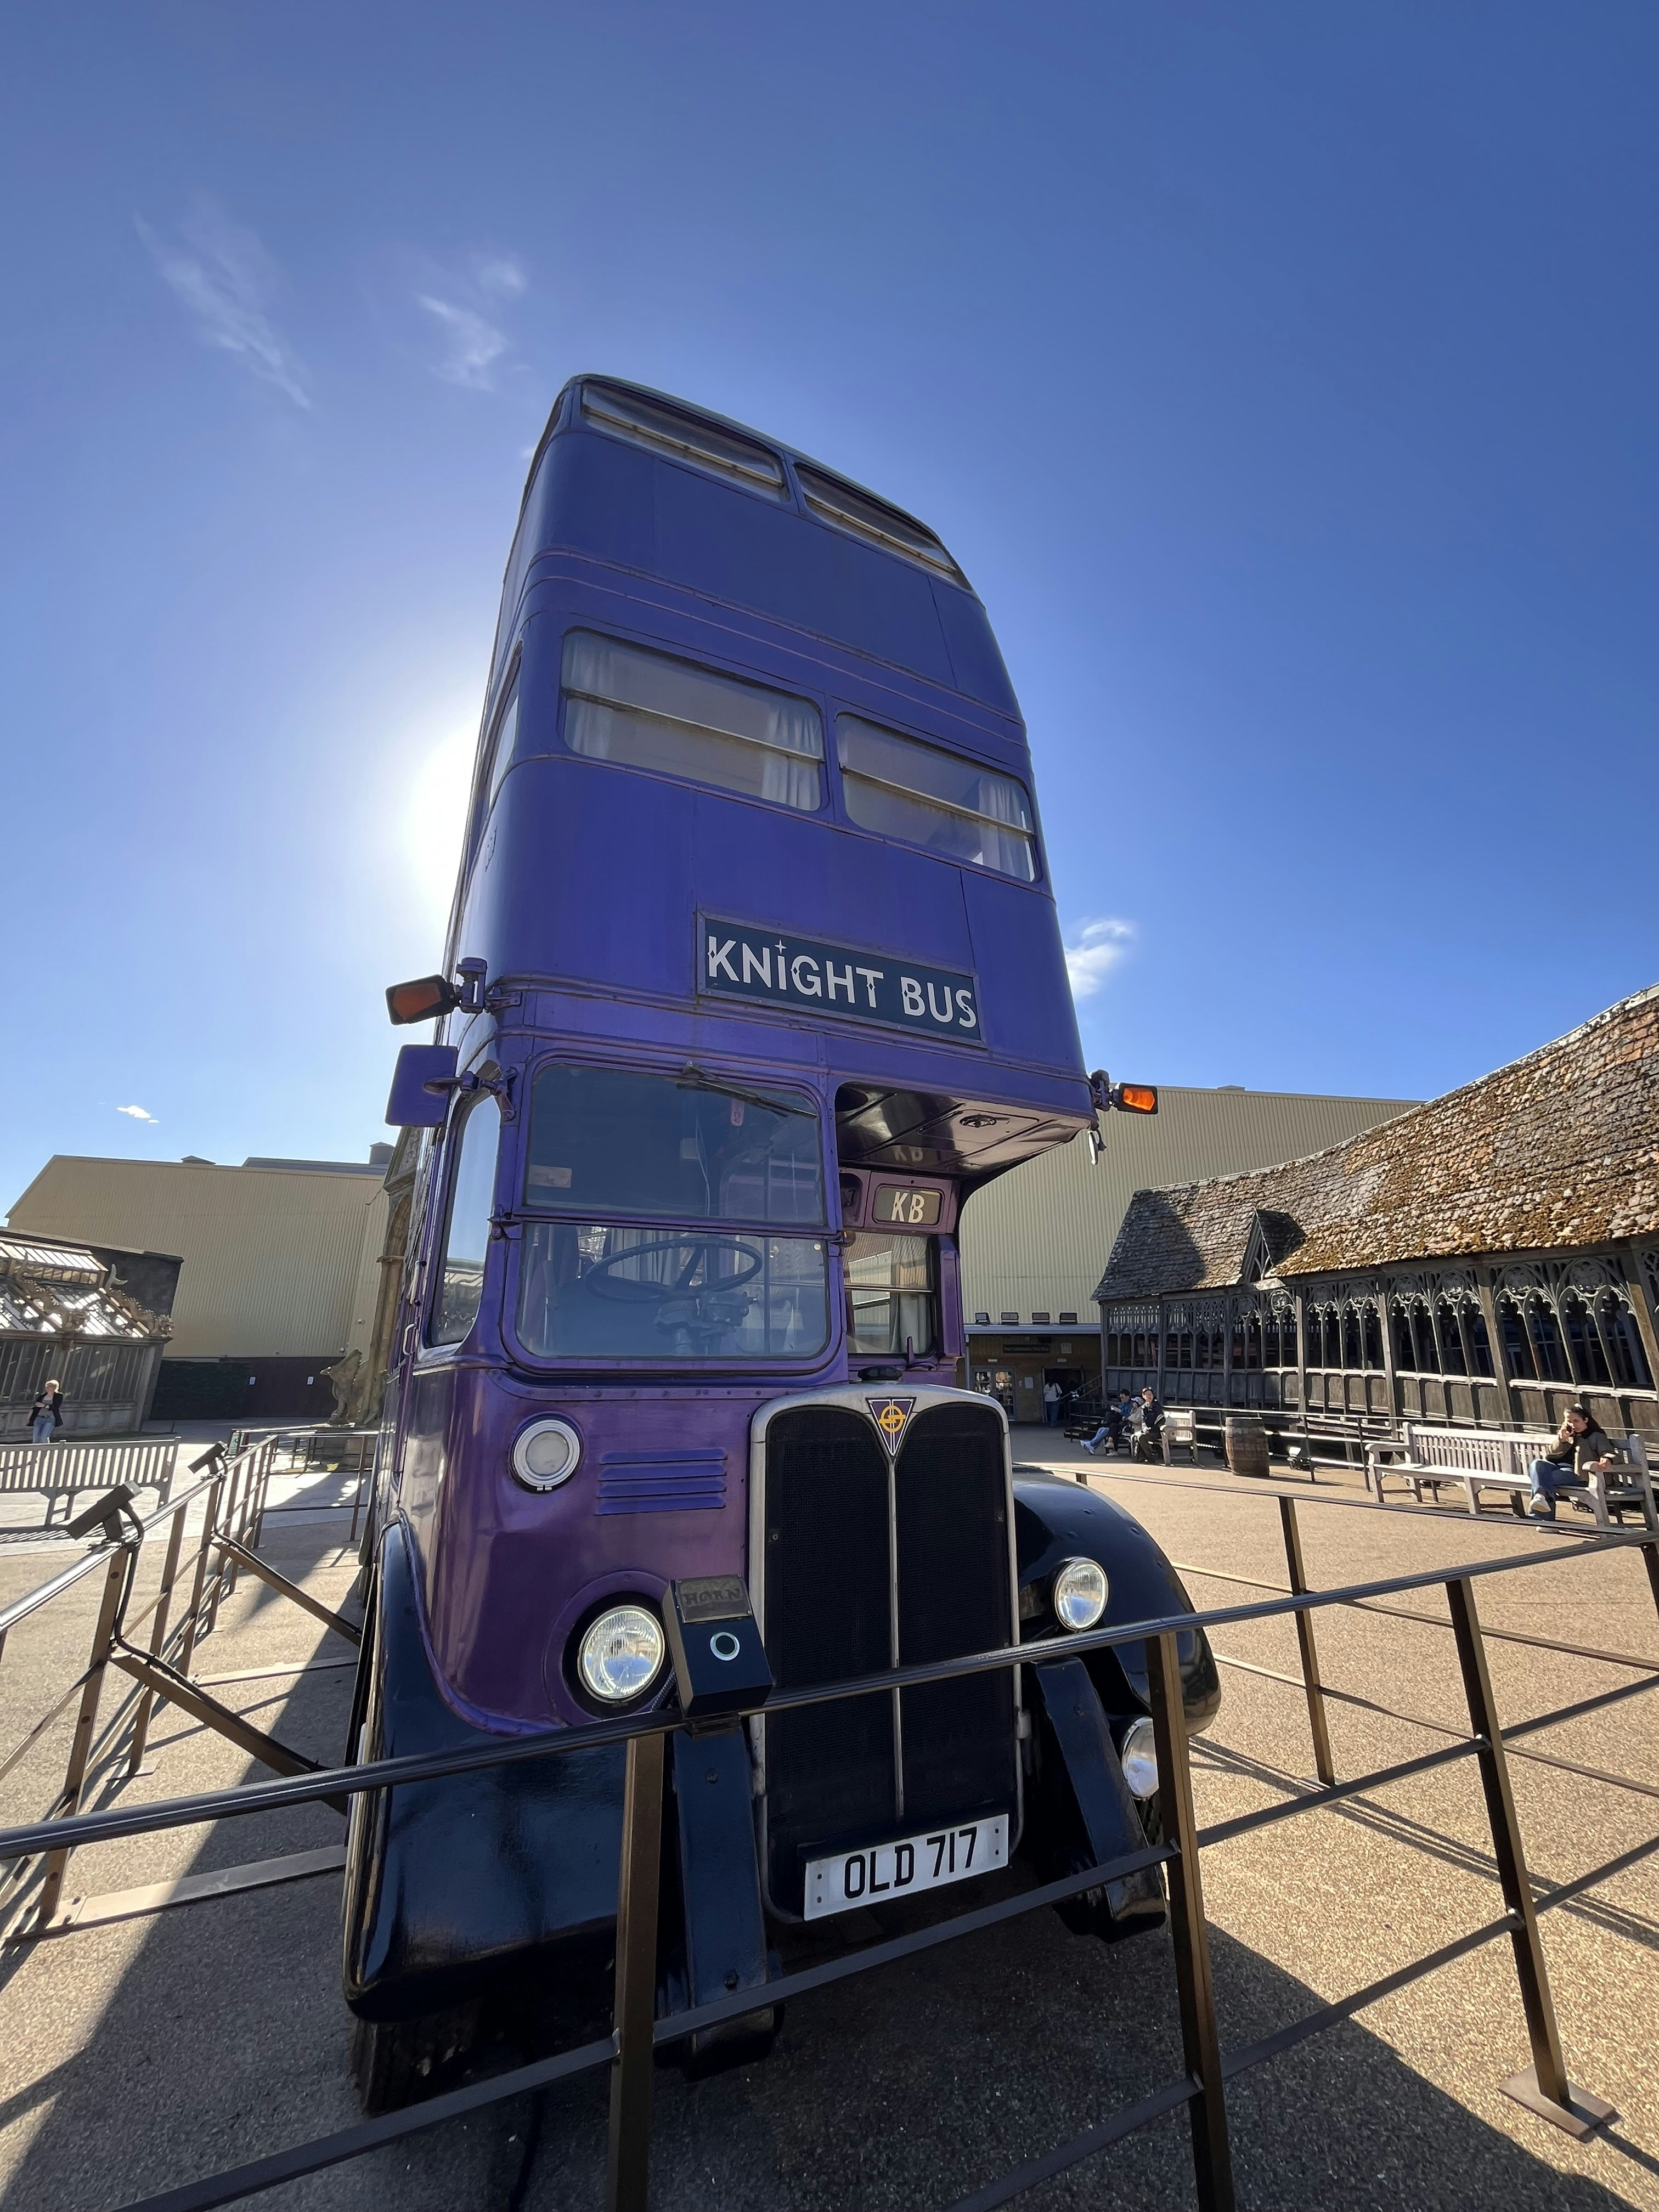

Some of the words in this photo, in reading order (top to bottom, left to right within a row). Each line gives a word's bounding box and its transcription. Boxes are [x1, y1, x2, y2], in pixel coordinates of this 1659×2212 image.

[900, 977, 977, 1028] BUS
[891, 1192, 925, 1223] KB
[681, 1587, 741, 1605] HORN
[844, 1843, 915, 1899] OLD
[926, 1826, 978, 1878] 717
